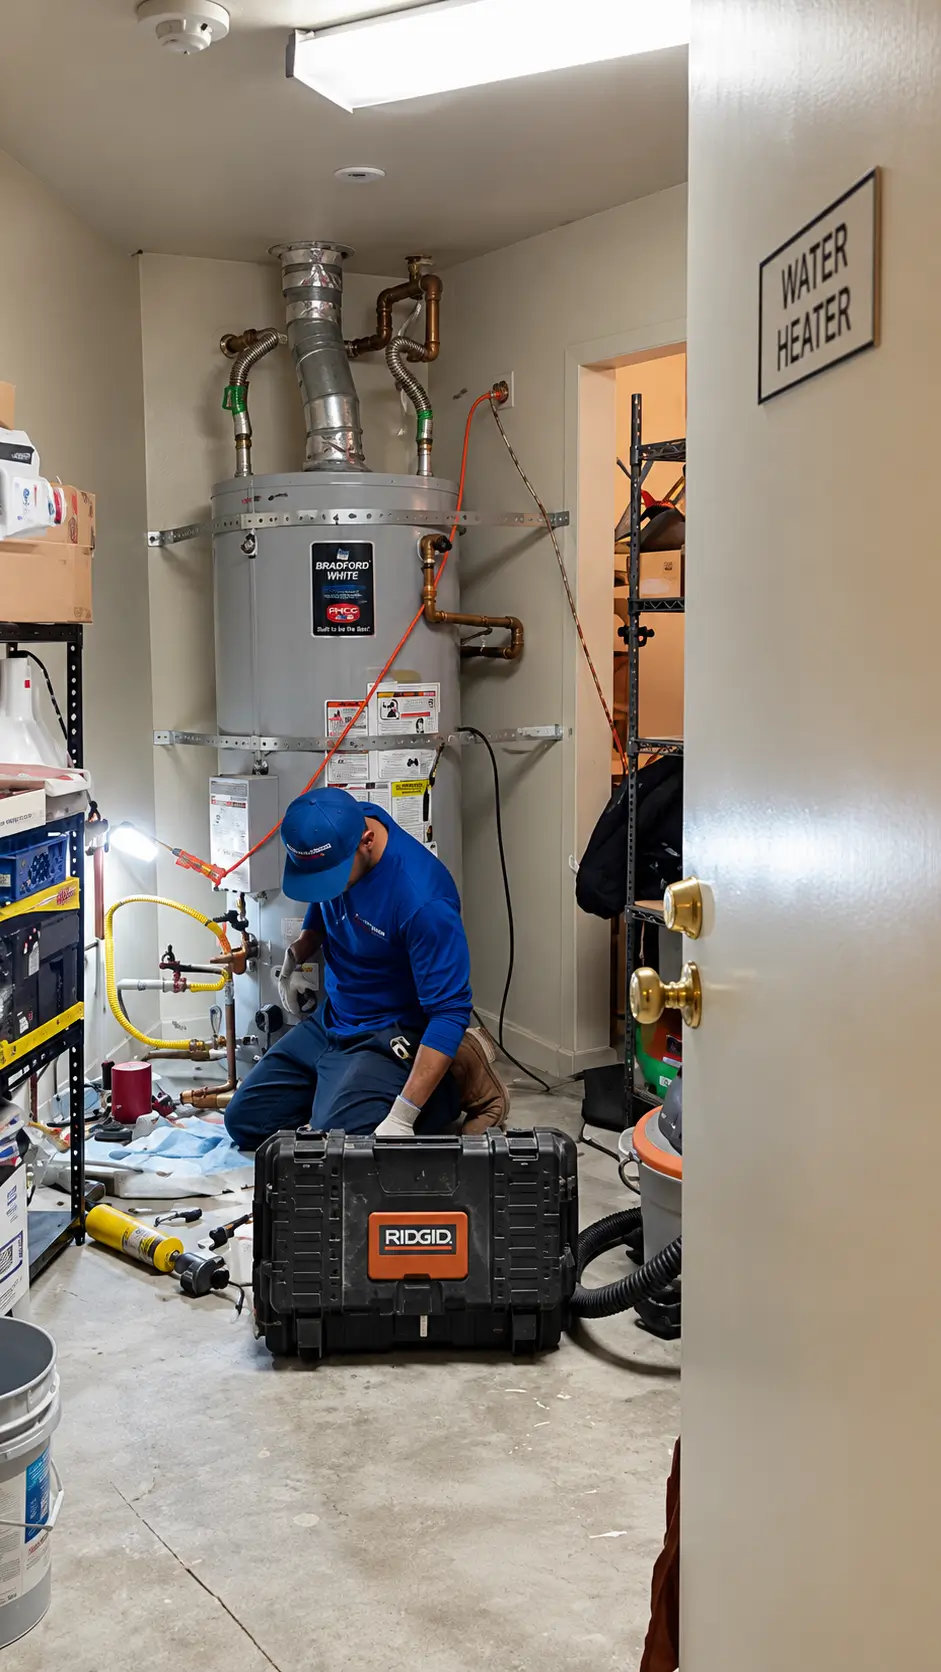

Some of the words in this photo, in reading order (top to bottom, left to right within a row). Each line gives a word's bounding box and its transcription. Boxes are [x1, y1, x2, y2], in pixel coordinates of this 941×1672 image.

[781, 222, 848, 310] WATER
[777, 285, 852, 372] HEATER
[315, 561, 370, 570] BRADFORD
[327, 571, 359, 580] WHITE
